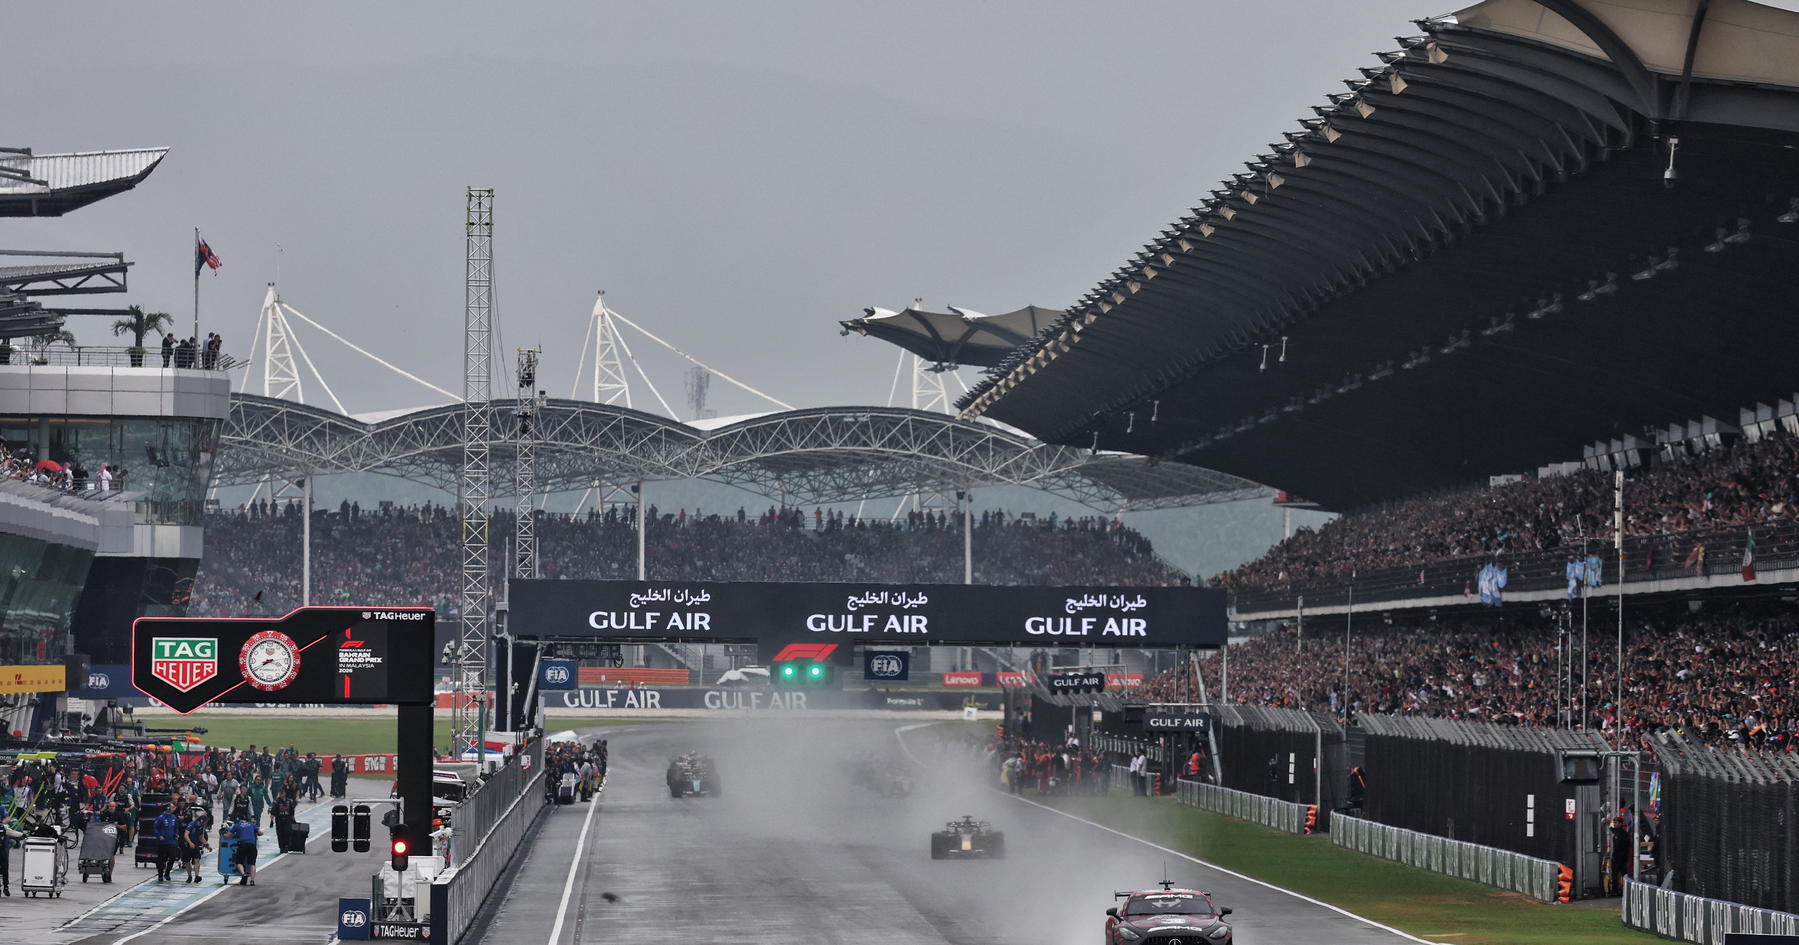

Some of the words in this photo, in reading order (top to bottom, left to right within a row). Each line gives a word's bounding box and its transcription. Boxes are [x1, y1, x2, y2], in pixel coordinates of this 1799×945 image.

[629, 588, 671, 608] الخليج
[674, 589, 711, 606] طيران
[847, 591, 888, 611] الخليج
[891, 591, 928, 609] طيران
[1065, 594, 1107, 614] الخليج
[1110, 594, 1147, 612] طيران
[588, 611, 661, 630] GULF
[666, 612, 711, 631] AIR
[806, 614, 878, 632] GULF
[883, 614, 928, 634] AIR
[1025, 617, 1097, 635] GULF
[1102, 617, 1147, 637] AIR
[158, 641, 212, 658] TAG
[156, 662, 214, 688] HEUER
[547, 669, 567, 681] FIA
[872, 659, 900, 674] FIA
[944, 675, 979, 685] Lenovo
[1053, 678, 1080, 687] GULF
[1082, 677, 1099, 686] AIR
[563, 690, 619, 708] GULF
[625, 690, 661, 708] AIR
[704, 691, 763, 710] GULF
[768, 692, 807, 710] AIR
[1149, 718, 1182, 727] GULF
[1184, 718, 1204, 727] AIR
[343, 913, 364, 924] FIA
